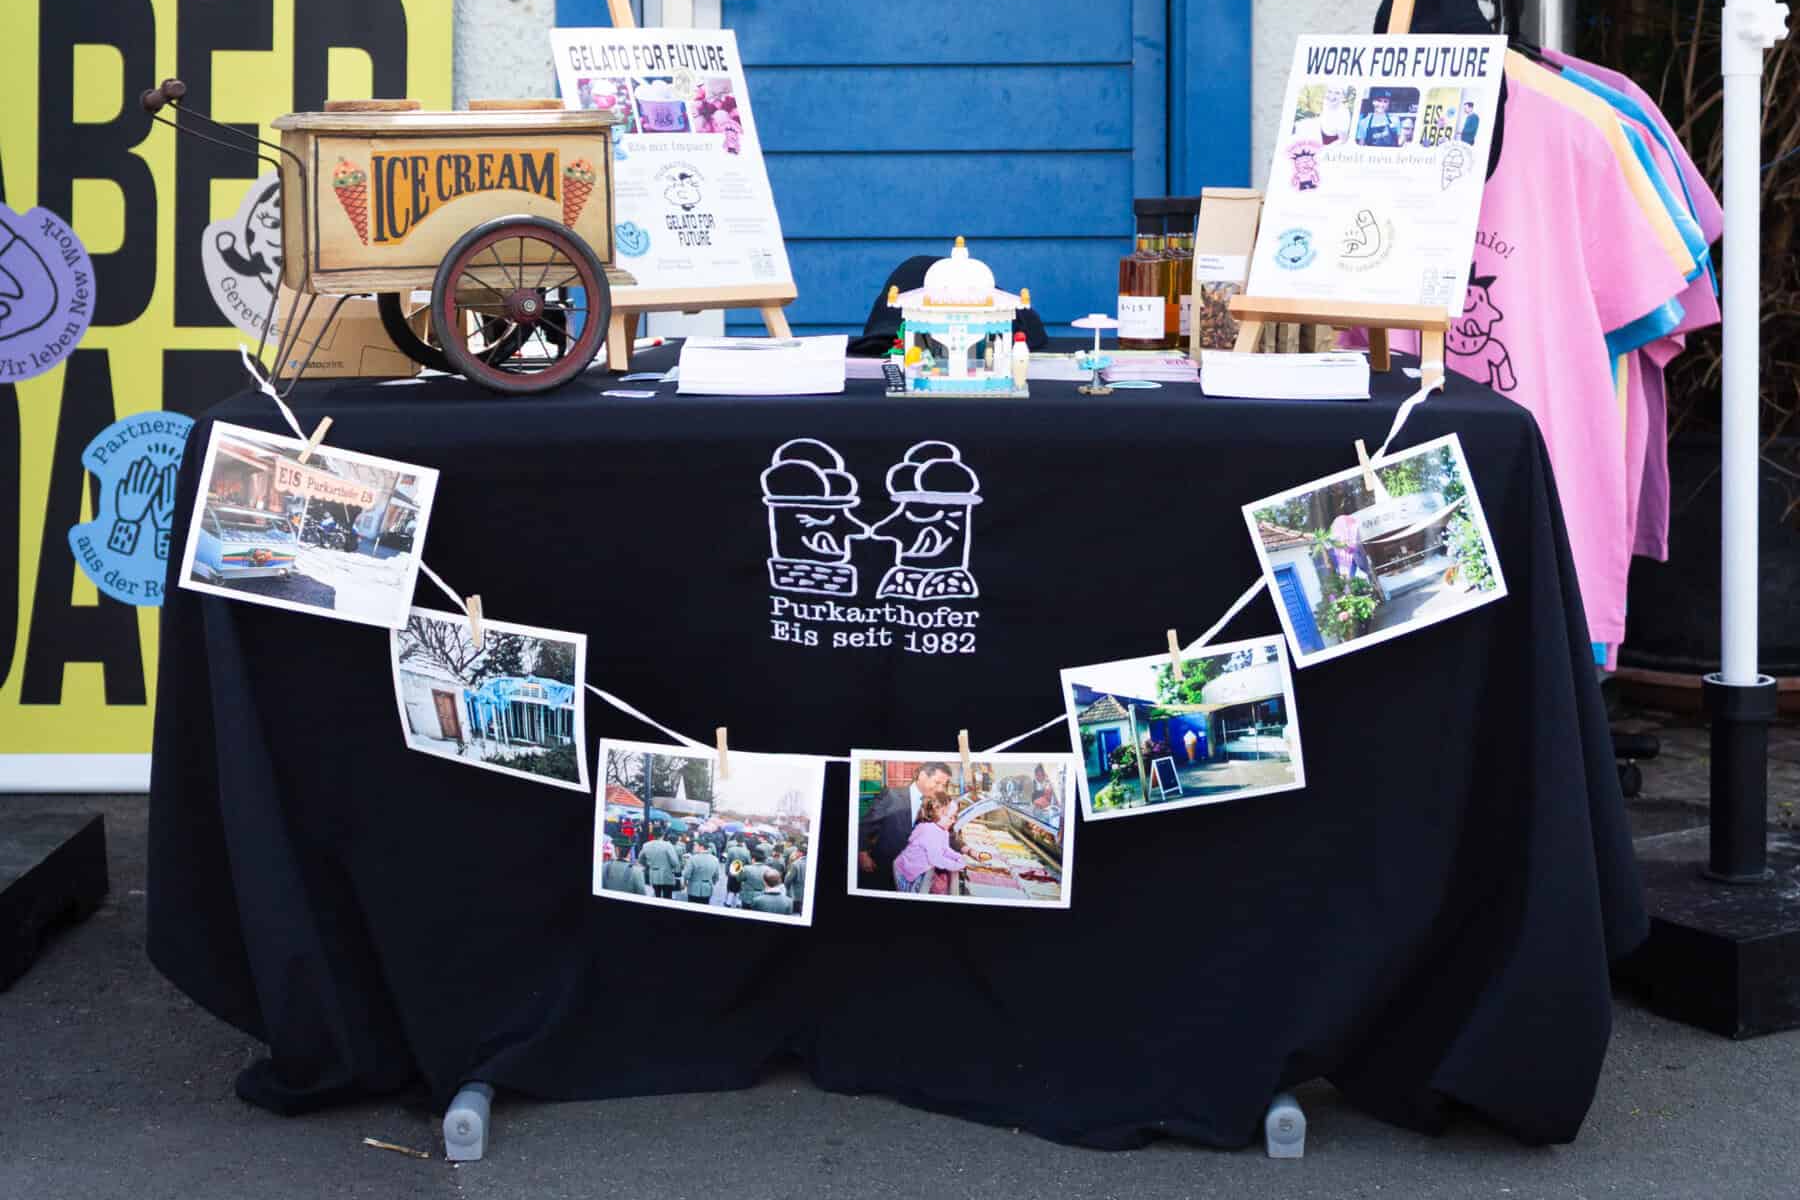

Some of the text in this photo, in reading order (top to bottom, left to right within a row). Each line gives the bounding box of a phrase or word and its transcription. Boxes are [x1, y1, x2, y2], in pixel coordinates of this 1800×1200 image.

[568, 44, 729, 72] GELATO FOR FUTURE
[1306, 47, 1490, 78] WORK FOR FUTURE
[372, 155, 430, 242] ICE
[436, 152, 557, 201] CREAM
[40, 217, 81, 268] Work
[665, 214, 697, 230] GELATO
[698, 214, 715, 231] FOR
[69, 270, 89, 316] New
[29, 321, 81, 369] leben
[77, 535, 104, 573] aus
[103, 568, 140, 595] der
[769, 595, 981, 629] Purkarthofer
[770, 620, 977, 655] Eis seit 1982
